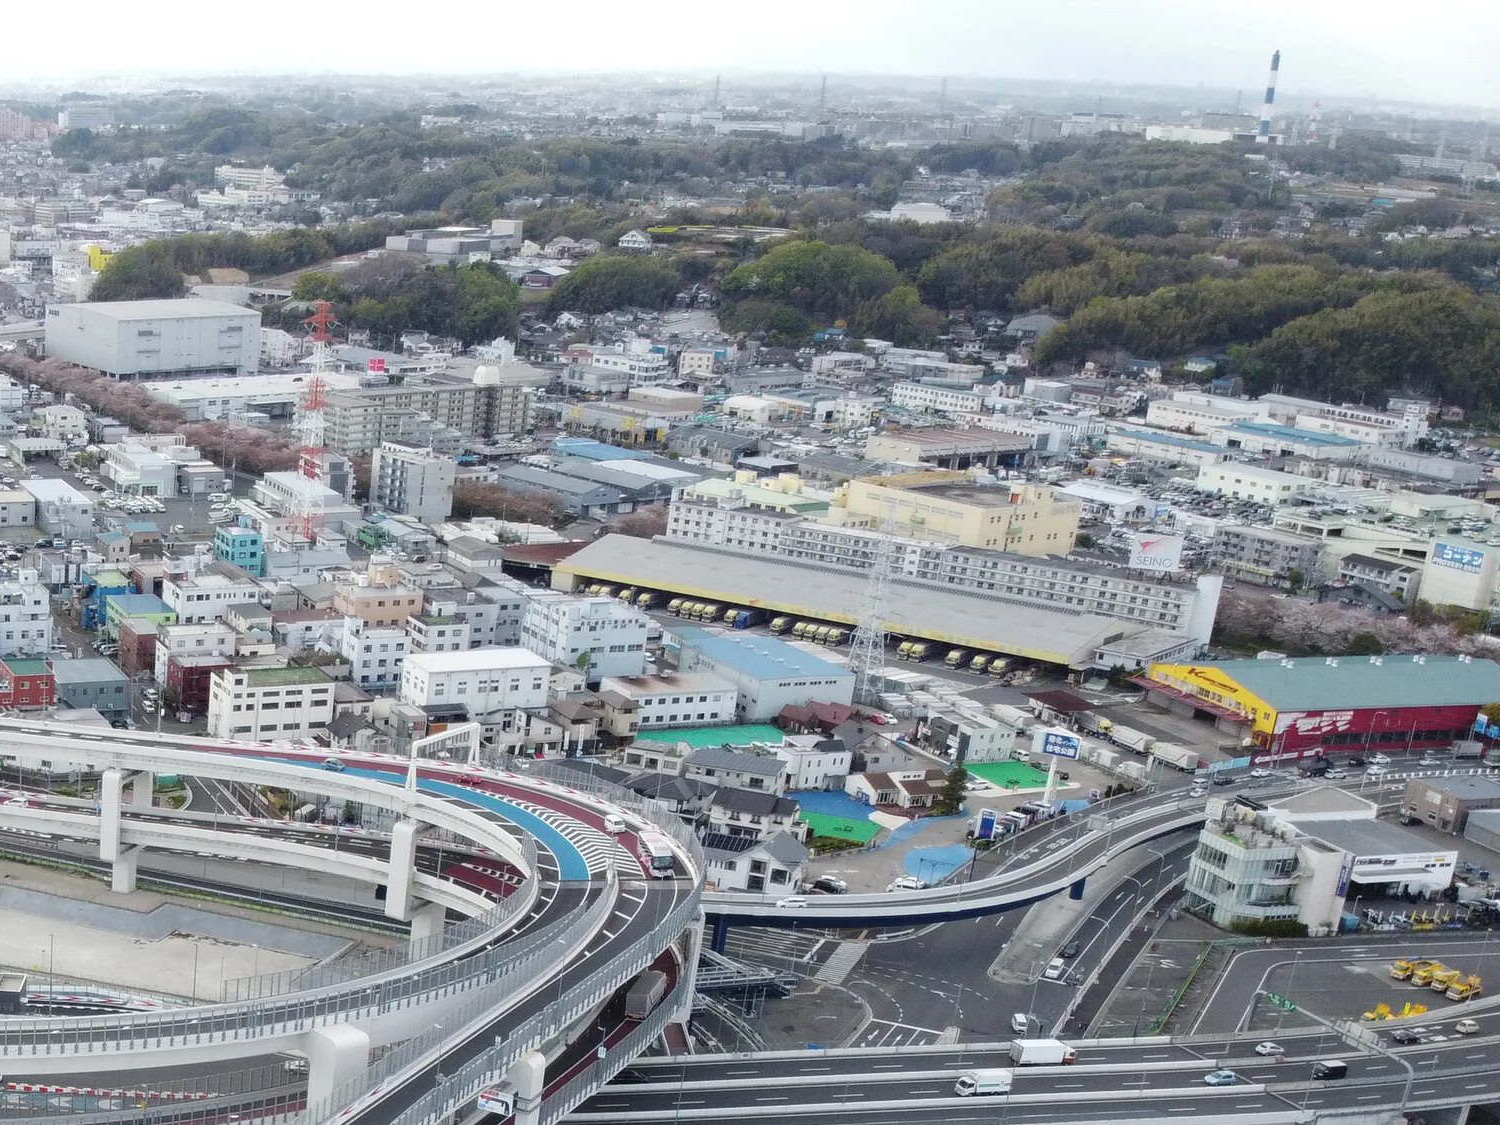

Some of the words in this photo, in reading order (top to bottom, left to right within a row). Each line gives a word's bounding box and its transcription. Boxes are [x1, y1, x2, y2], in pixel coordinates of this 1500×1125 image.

[1136, 556, 1173, 568] SEINO
[1442, 549, 1482, 566] コーナン
